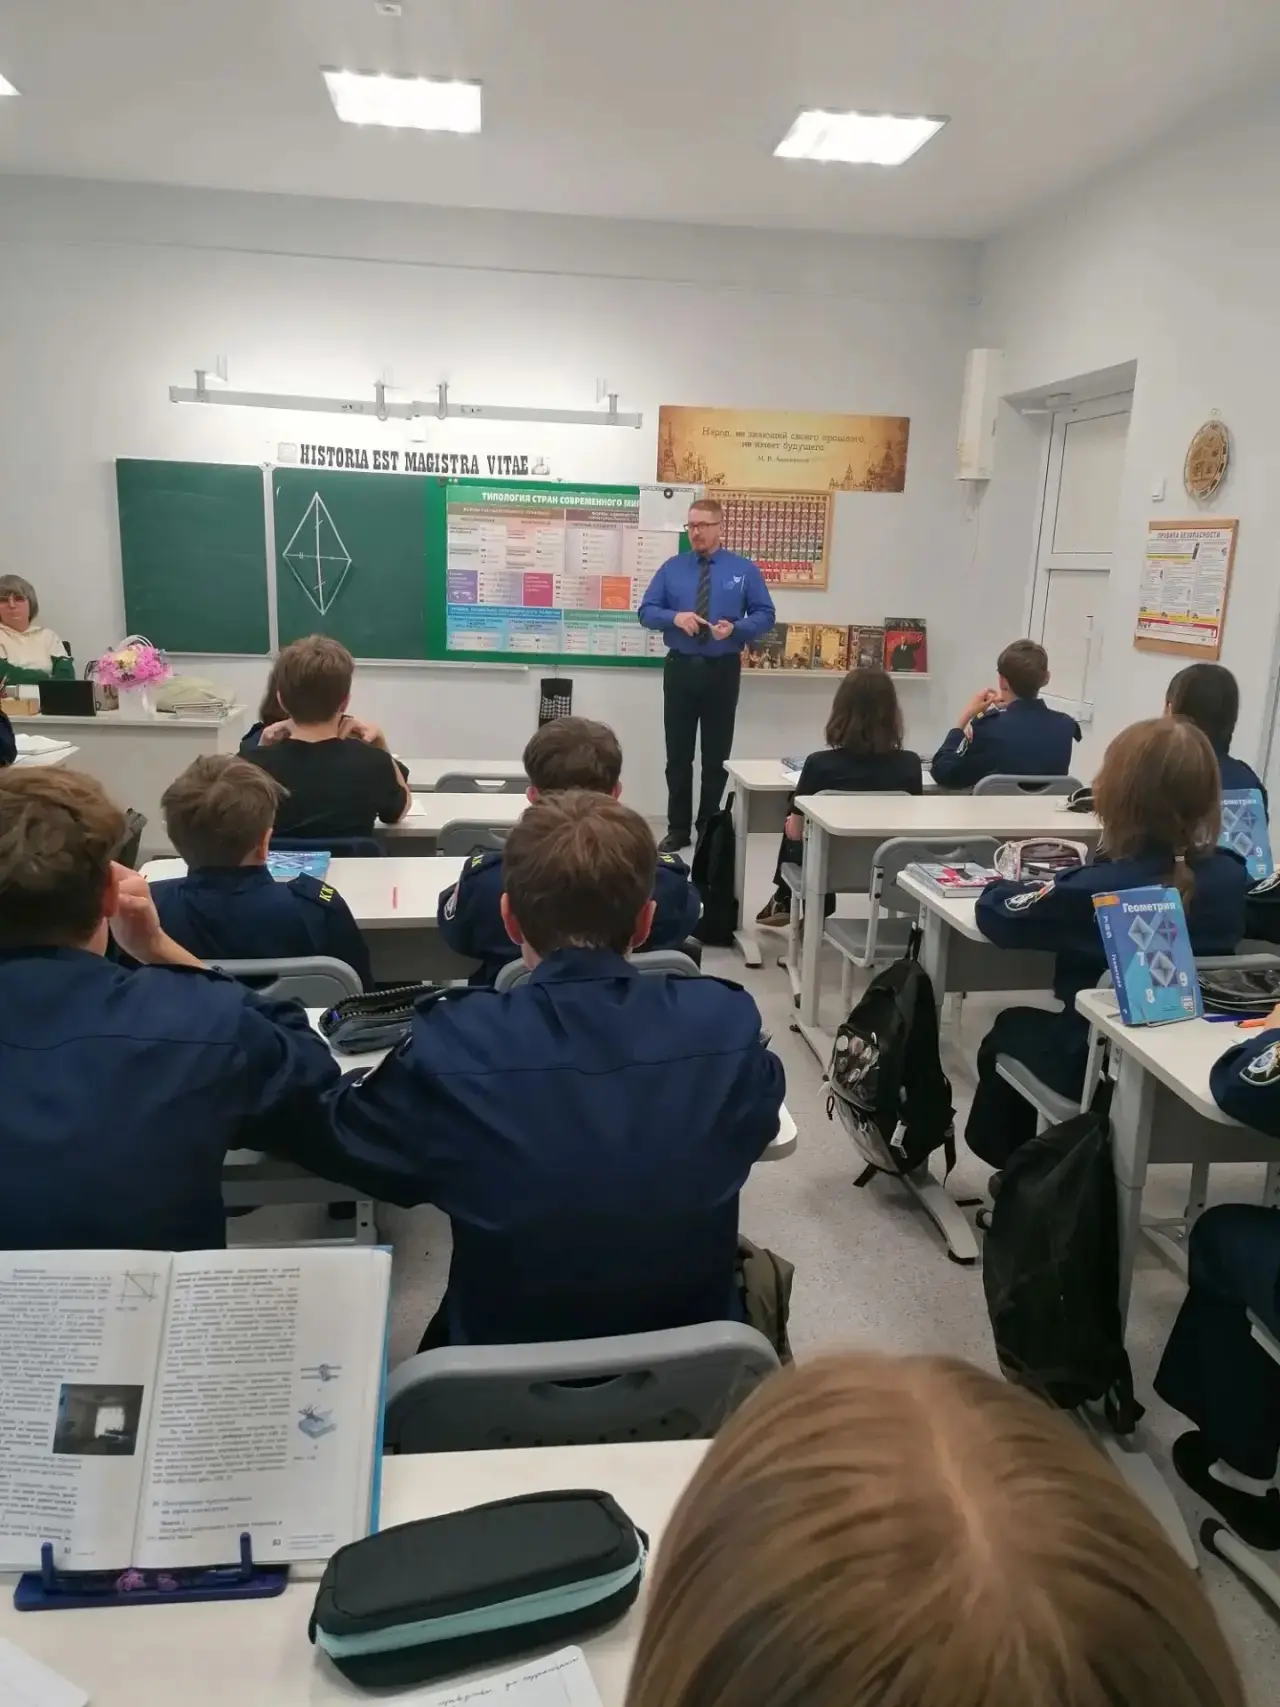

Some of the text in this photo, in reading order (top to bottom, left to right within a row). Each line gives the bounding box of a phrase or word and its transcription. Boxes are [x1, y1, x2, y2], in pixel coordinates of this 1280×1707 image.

[300, 443, 529, 475] HISTORIA EST MAGISTRA VITAE
[481, 492, 530, 503] ТИПОЛОГИЯ
[532, 495, 558, 504] СТРАН
[560, 496, 622, 507] СОВРЕМЕННОГО
[1255, 846, 1263, 857] 9
[1122, 902, 1177, 914] Геометрия
[1136, 951, 1145, 966] 7
[1179, 971, 1188, 987] 9
[1145, 988, 1156, 1004] 8
